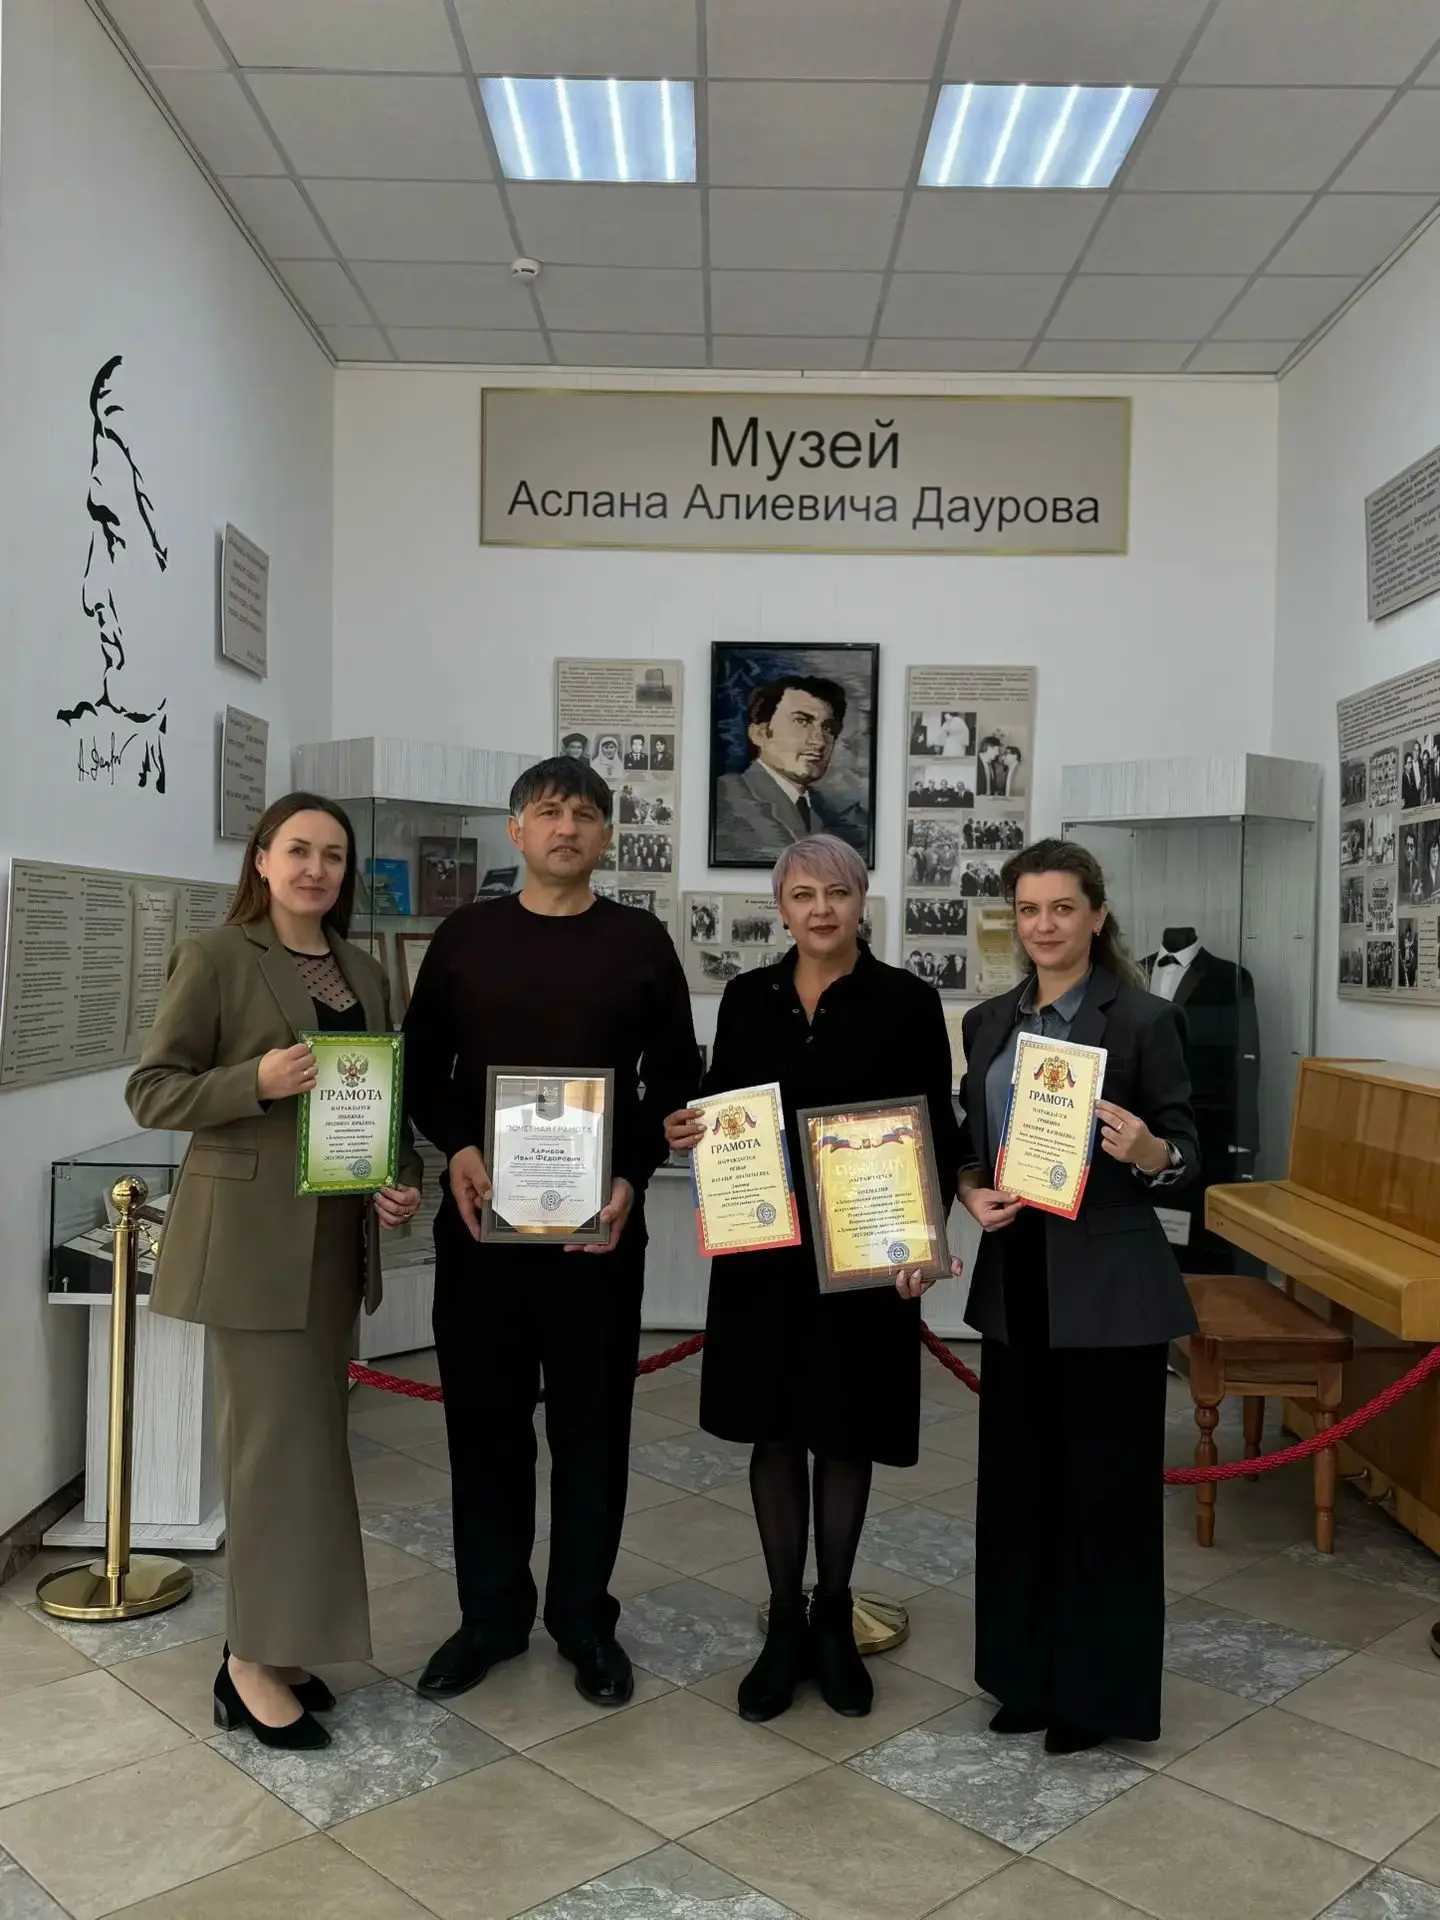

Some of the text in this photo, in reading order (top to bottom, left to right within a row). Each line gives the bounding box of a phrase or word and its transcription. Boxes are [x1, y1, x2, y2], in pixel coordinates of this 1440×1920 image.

[710, 416, 901, 481] Музей
[507, 479, 1100, 532] Аслана Алиевича Даурова
[320, 1089, 382, 1101] ГРАМОТА
[1029, 1089, 1075, 1109] ГРАМОТА
[710, 1138, 762, 1154] ГРАМОТА
